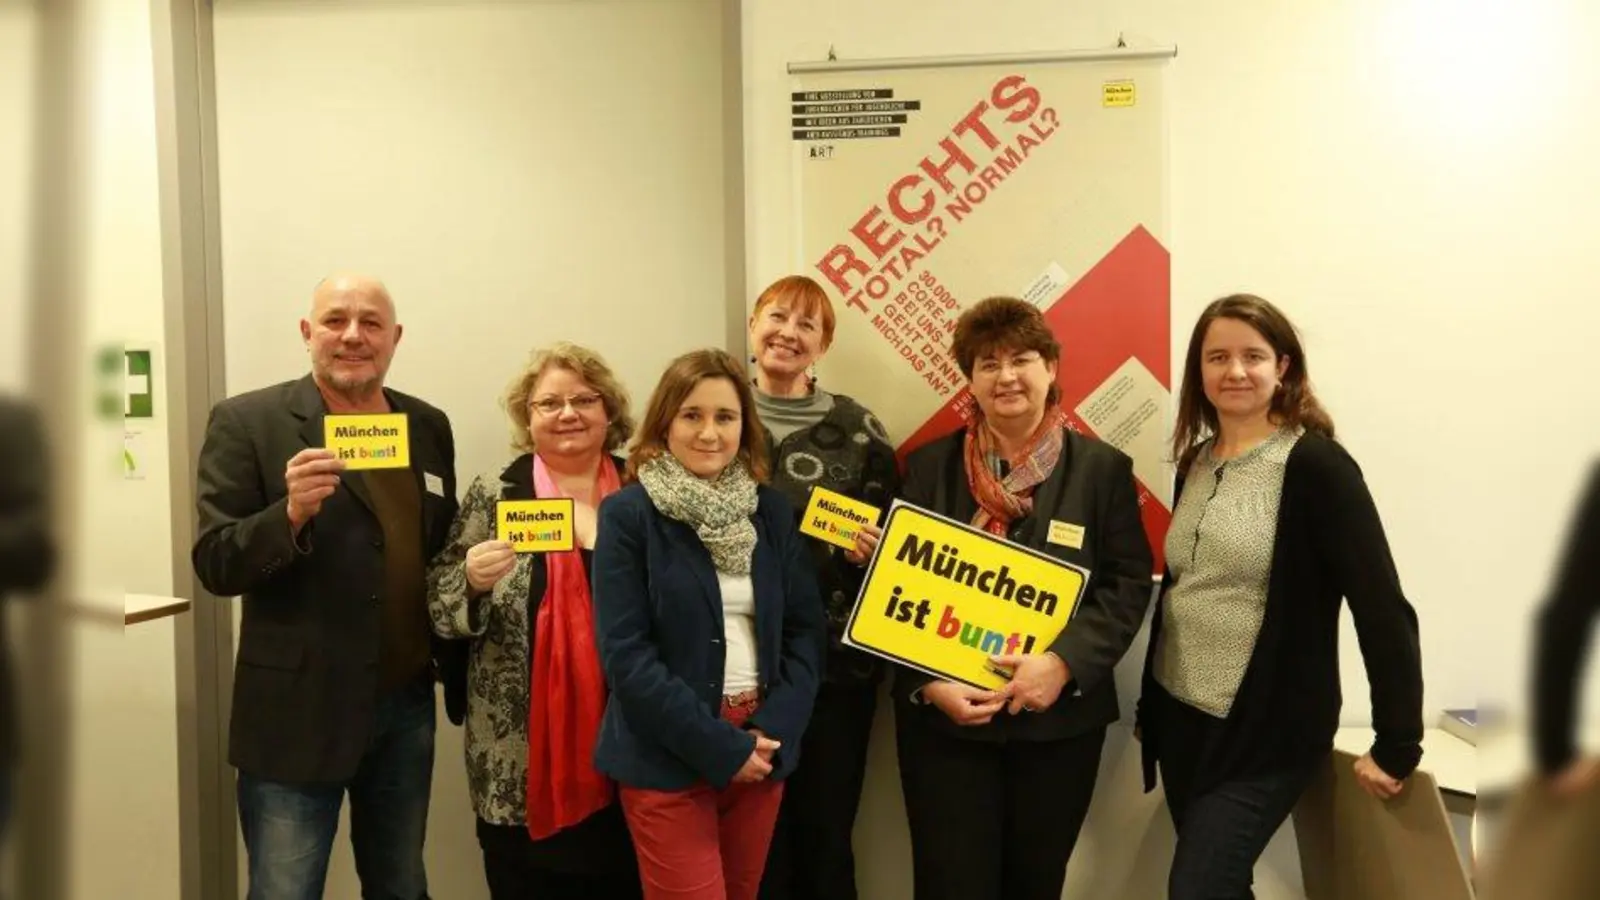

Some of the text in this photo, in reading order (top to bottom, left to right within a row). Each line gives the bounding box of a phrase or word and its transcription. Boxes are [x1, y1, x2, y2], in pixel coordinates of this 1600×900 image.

[809, 145, 835, 158] ART
[815, 75, 1041, 297] RECHTS
[846, 107, 1060, 314] TOTAL? NORMAL?
[894, 291, 919, 317] BEI
[870, 314, 950, 396] MICH DAS AN?
[883, 303, 962, 387] GEHT DENN
[335, 425, 398, 438] München
[338, 445, 396, 459] ist bunt!
[506, 509, 564, 522] München
[811, 516, 828, 531] ist
[817, 497, 869, 524] München
[509, 529, 562, 542] ist bunt!
[895, 533, 1058, 617] München
[884, 585, 1036, 656] ist bunt!
